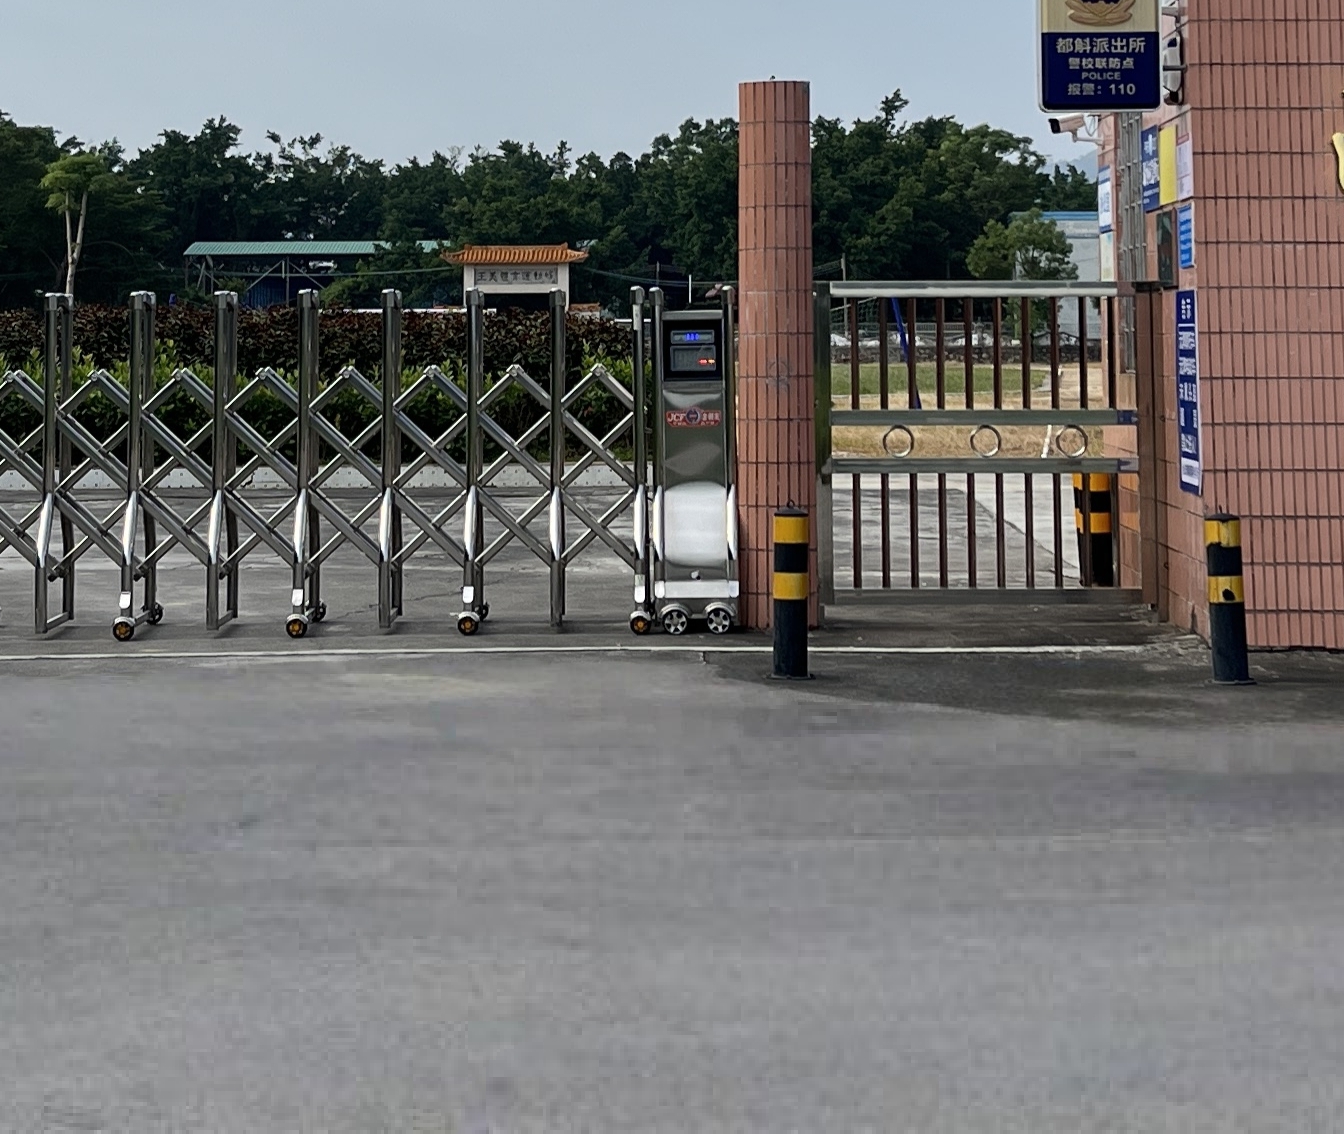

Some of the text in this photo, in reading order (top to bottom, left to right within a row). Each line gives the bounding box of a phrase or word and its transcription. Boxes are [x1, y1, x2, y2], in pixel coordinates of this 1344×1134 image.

[1056, 37, 1146, 54] 都斛派出所
[1068, 57, 1134, 70] 警校联防点
[1081, 71, 1121, 80] POLICE
